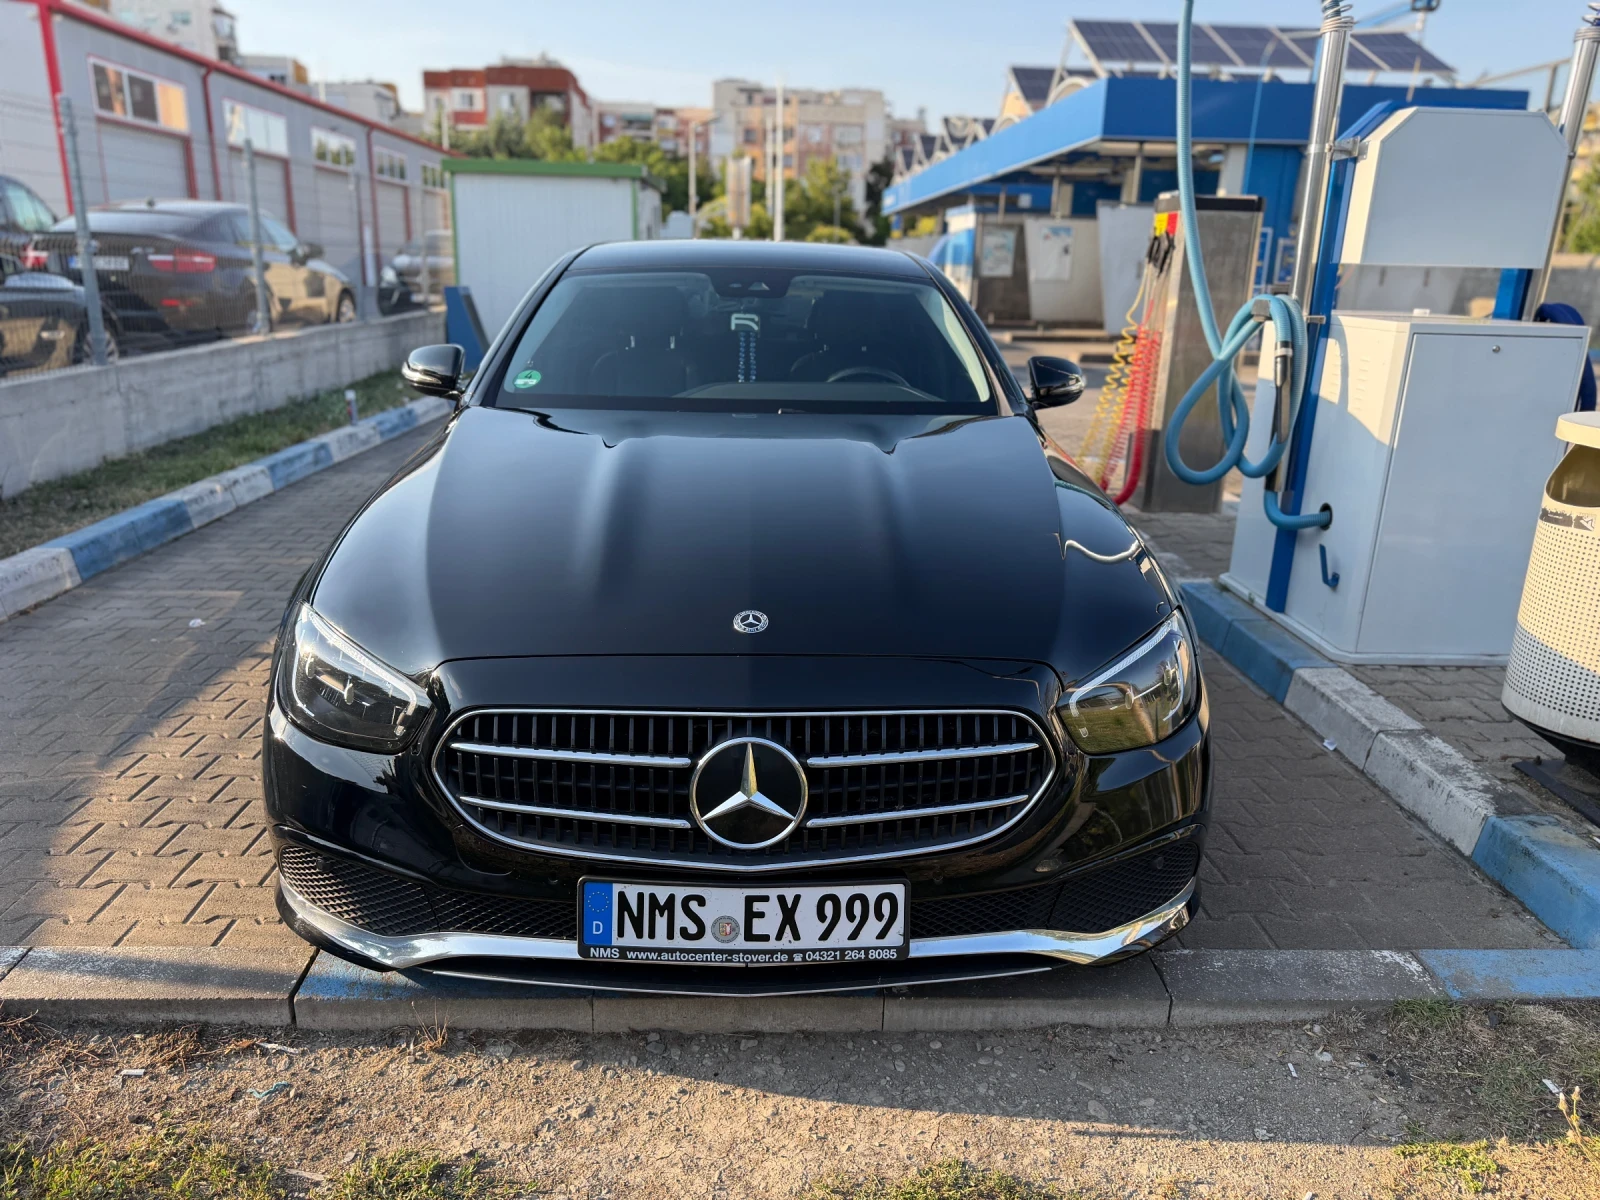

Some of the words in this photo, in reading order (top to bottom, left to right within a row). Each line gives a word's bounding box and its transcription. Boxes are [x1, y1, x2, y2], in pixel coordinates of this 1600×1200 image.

[617, 891, 706, 941] NMS
[743, 894, 802, 942] EX
[816, 892, 899, 941] 999
[592, 921, 603, 935] D
[590, 947, 620, 959] NMS
[626, 950, 789, 963] www.autocenter-stover.de
[805, 951, 841, 961] 04321
[844, 949, 866, 960] 264
[868, 949, 898, 960] 8085
